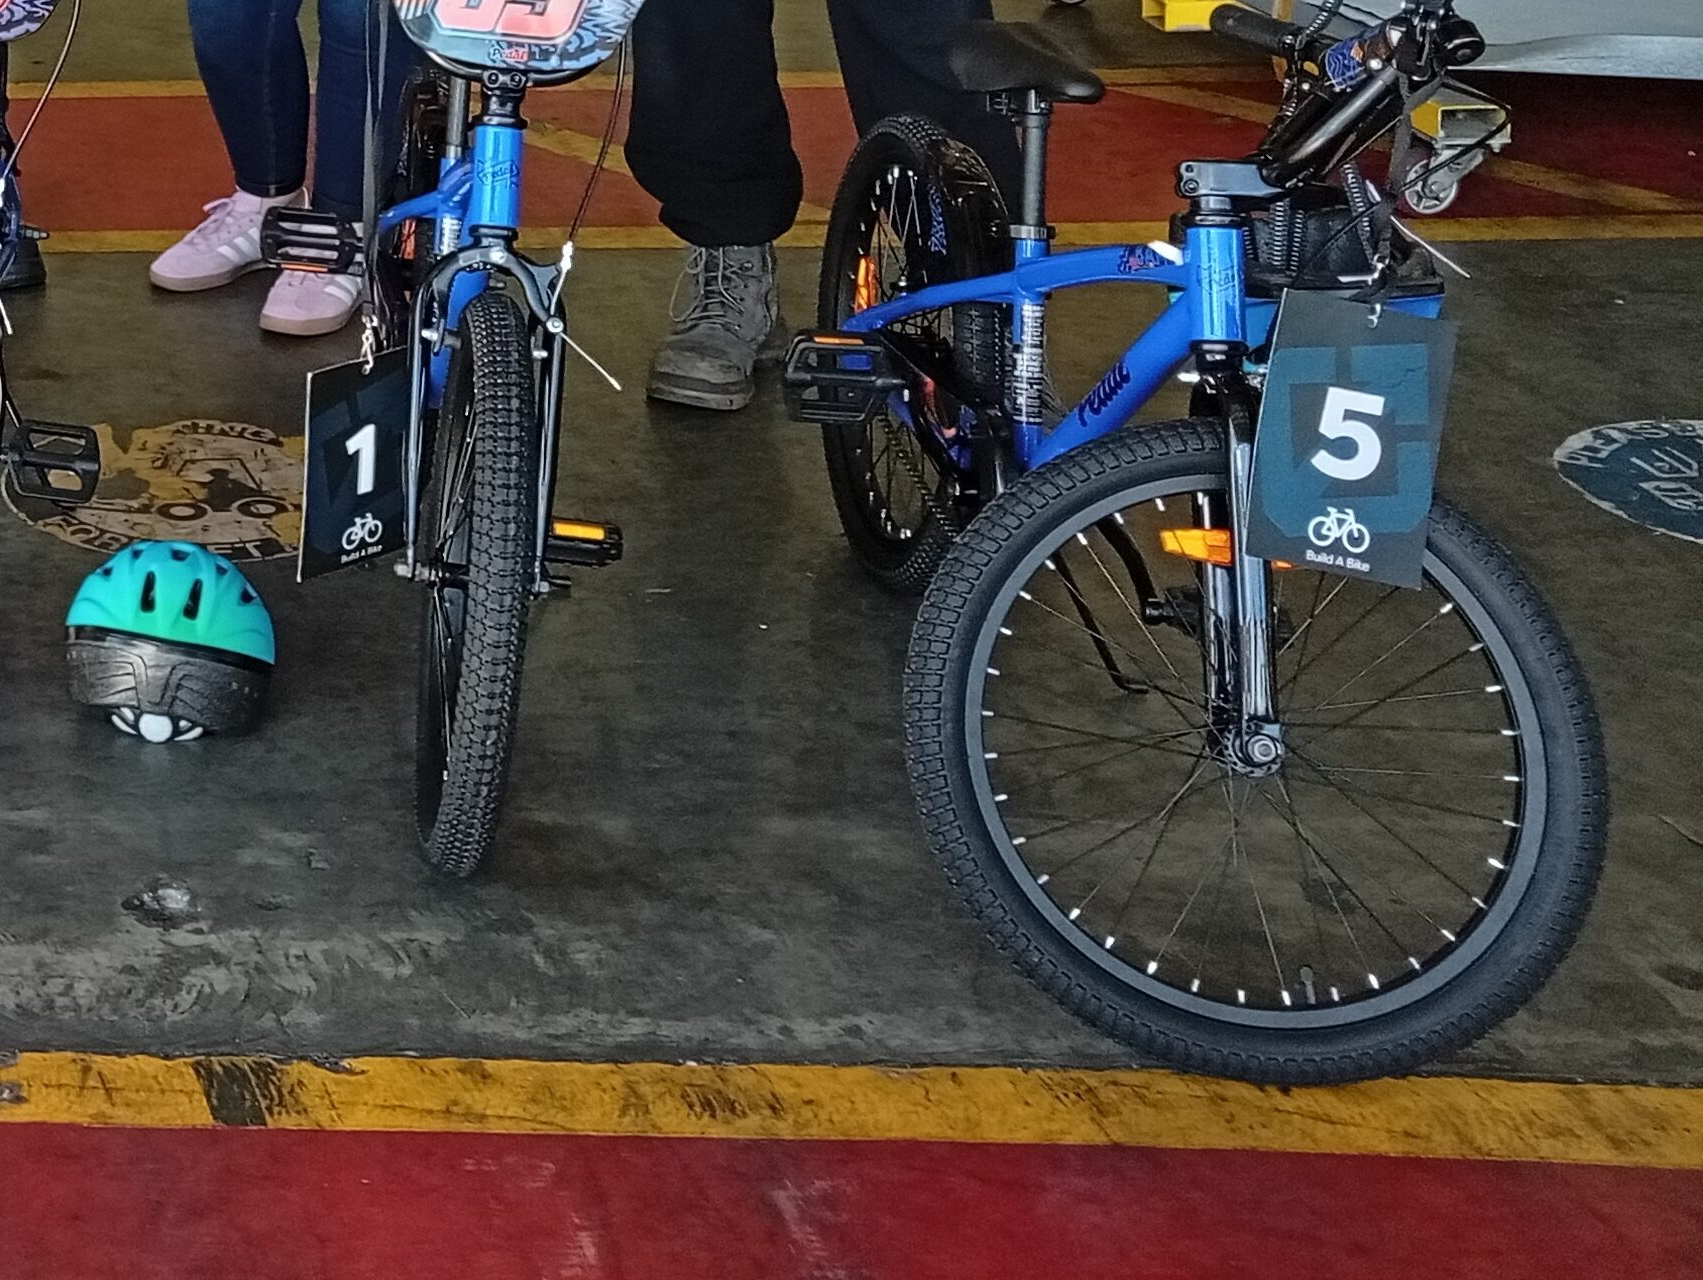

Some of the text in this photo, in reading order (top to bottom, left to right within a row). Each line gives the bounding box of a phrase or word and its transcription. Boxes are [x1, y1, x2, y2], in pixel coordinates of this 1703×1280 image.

[345, 423, 376, 496] 1
[1311, 386, 1385, 481] 5
[1305, 549, 1370, 572] Build A Bike
